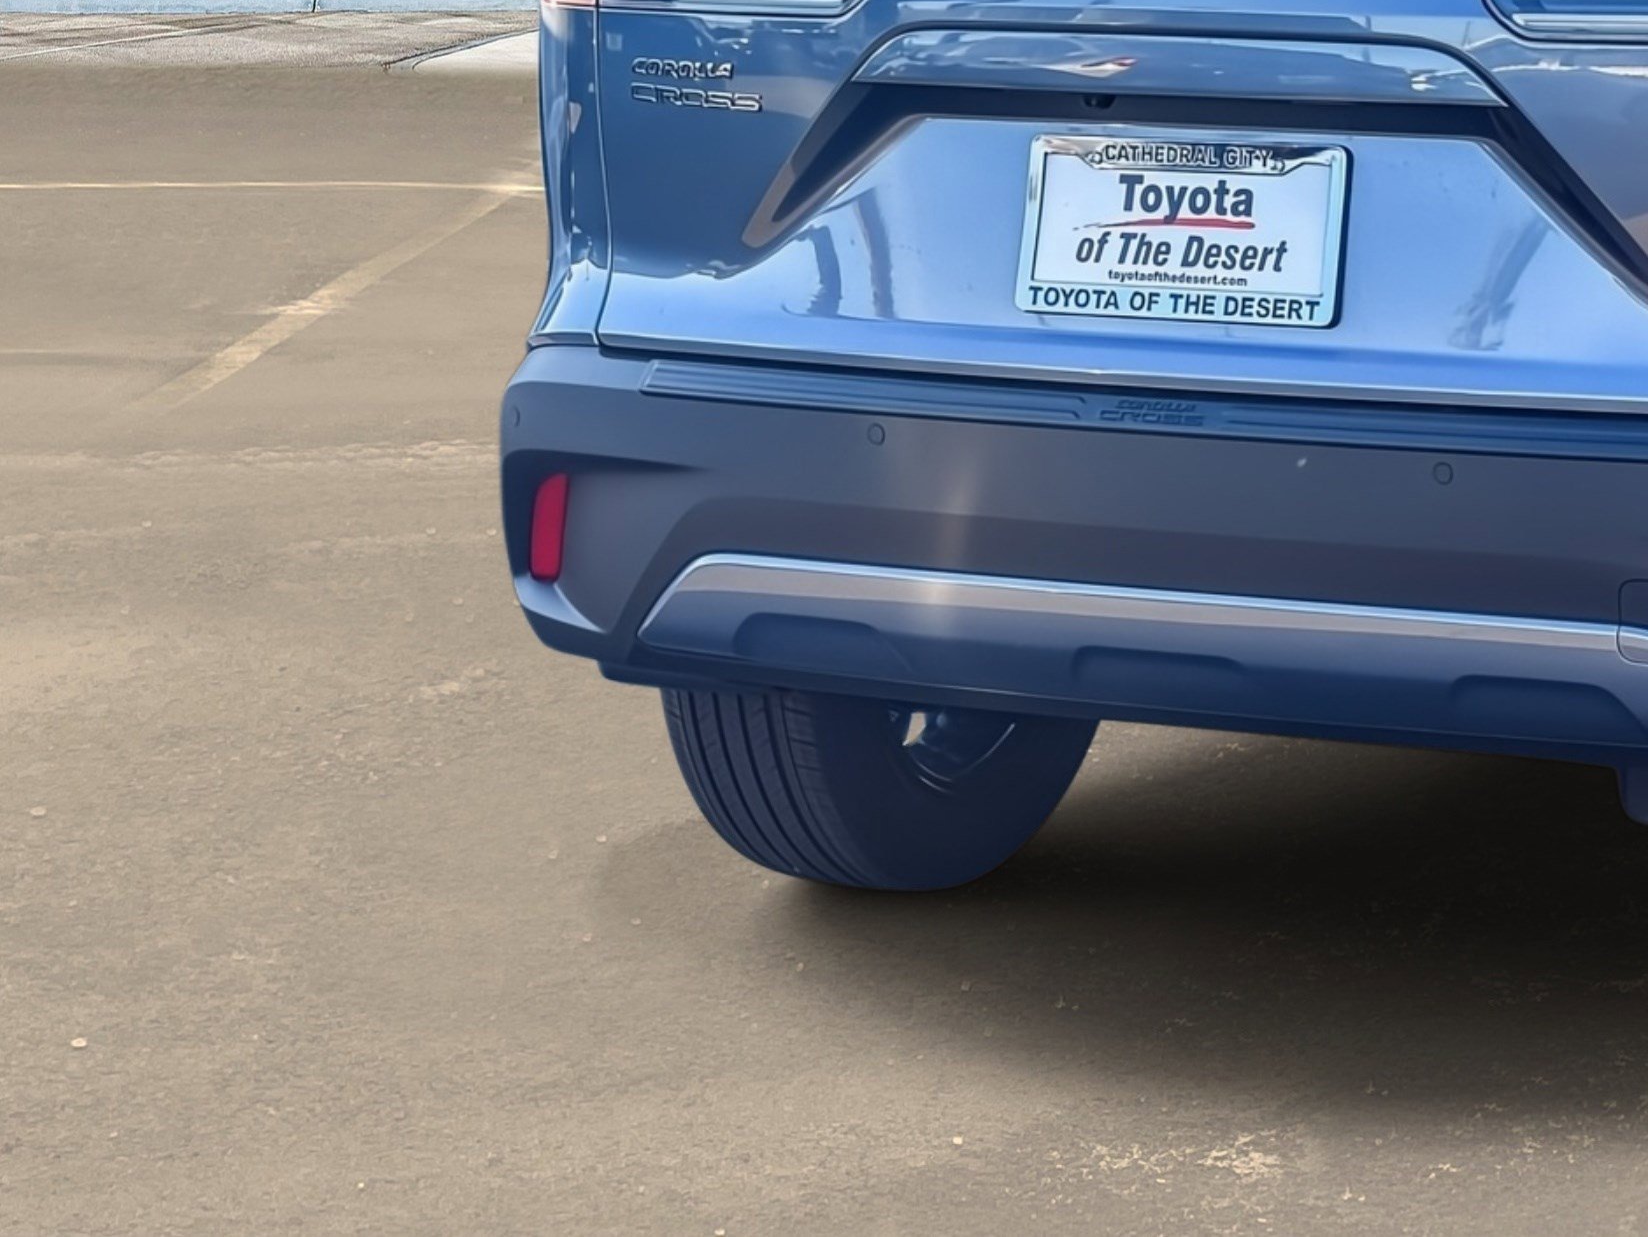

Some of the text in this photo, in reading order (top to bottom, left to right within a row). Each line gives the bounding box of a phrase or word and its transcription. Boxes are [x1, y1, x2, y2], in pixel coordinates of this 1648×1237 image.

[632, 56, 734, 80] COROLLA
[630, 81, 763, 112] CROSS
[1103, 144, 1273, 168] CATHEDRAL CITY
[1119, 173, 1255, 224] Toyota
[1074, 231, 1287, 273] of The Desert
[1108, 269, 1248, 287] toyotaofthedesert.com
[1028, 285, 1321, 321] TOYOTA OF THE DESERT
[1100, 409, 1205, 427] CROSS
